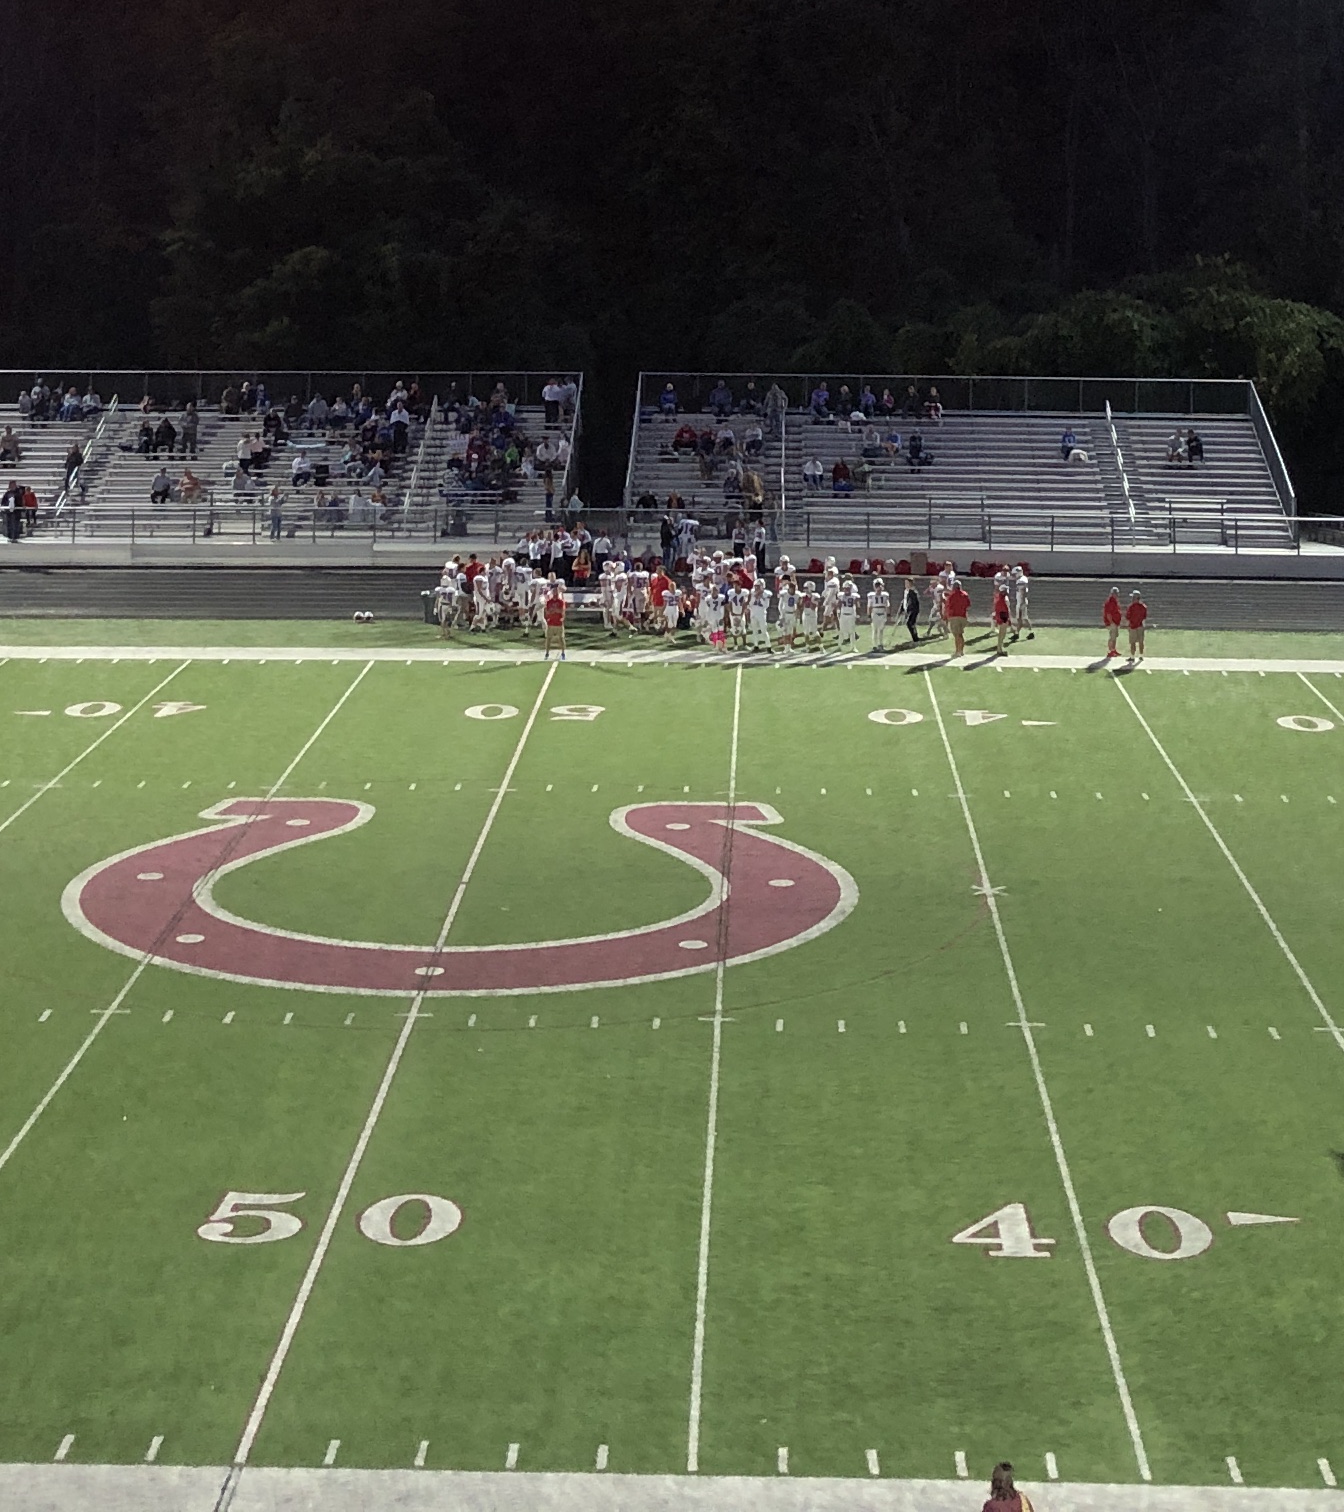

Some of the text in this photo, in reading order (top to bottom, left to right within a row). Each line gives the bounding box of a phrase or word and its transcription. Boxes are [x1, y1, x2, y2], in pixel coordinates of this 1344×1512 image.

[875, 596, 884, 604] 11
[196, 1190, 462, 1246] 50
[951, 1202, 1213, 1260] 40
